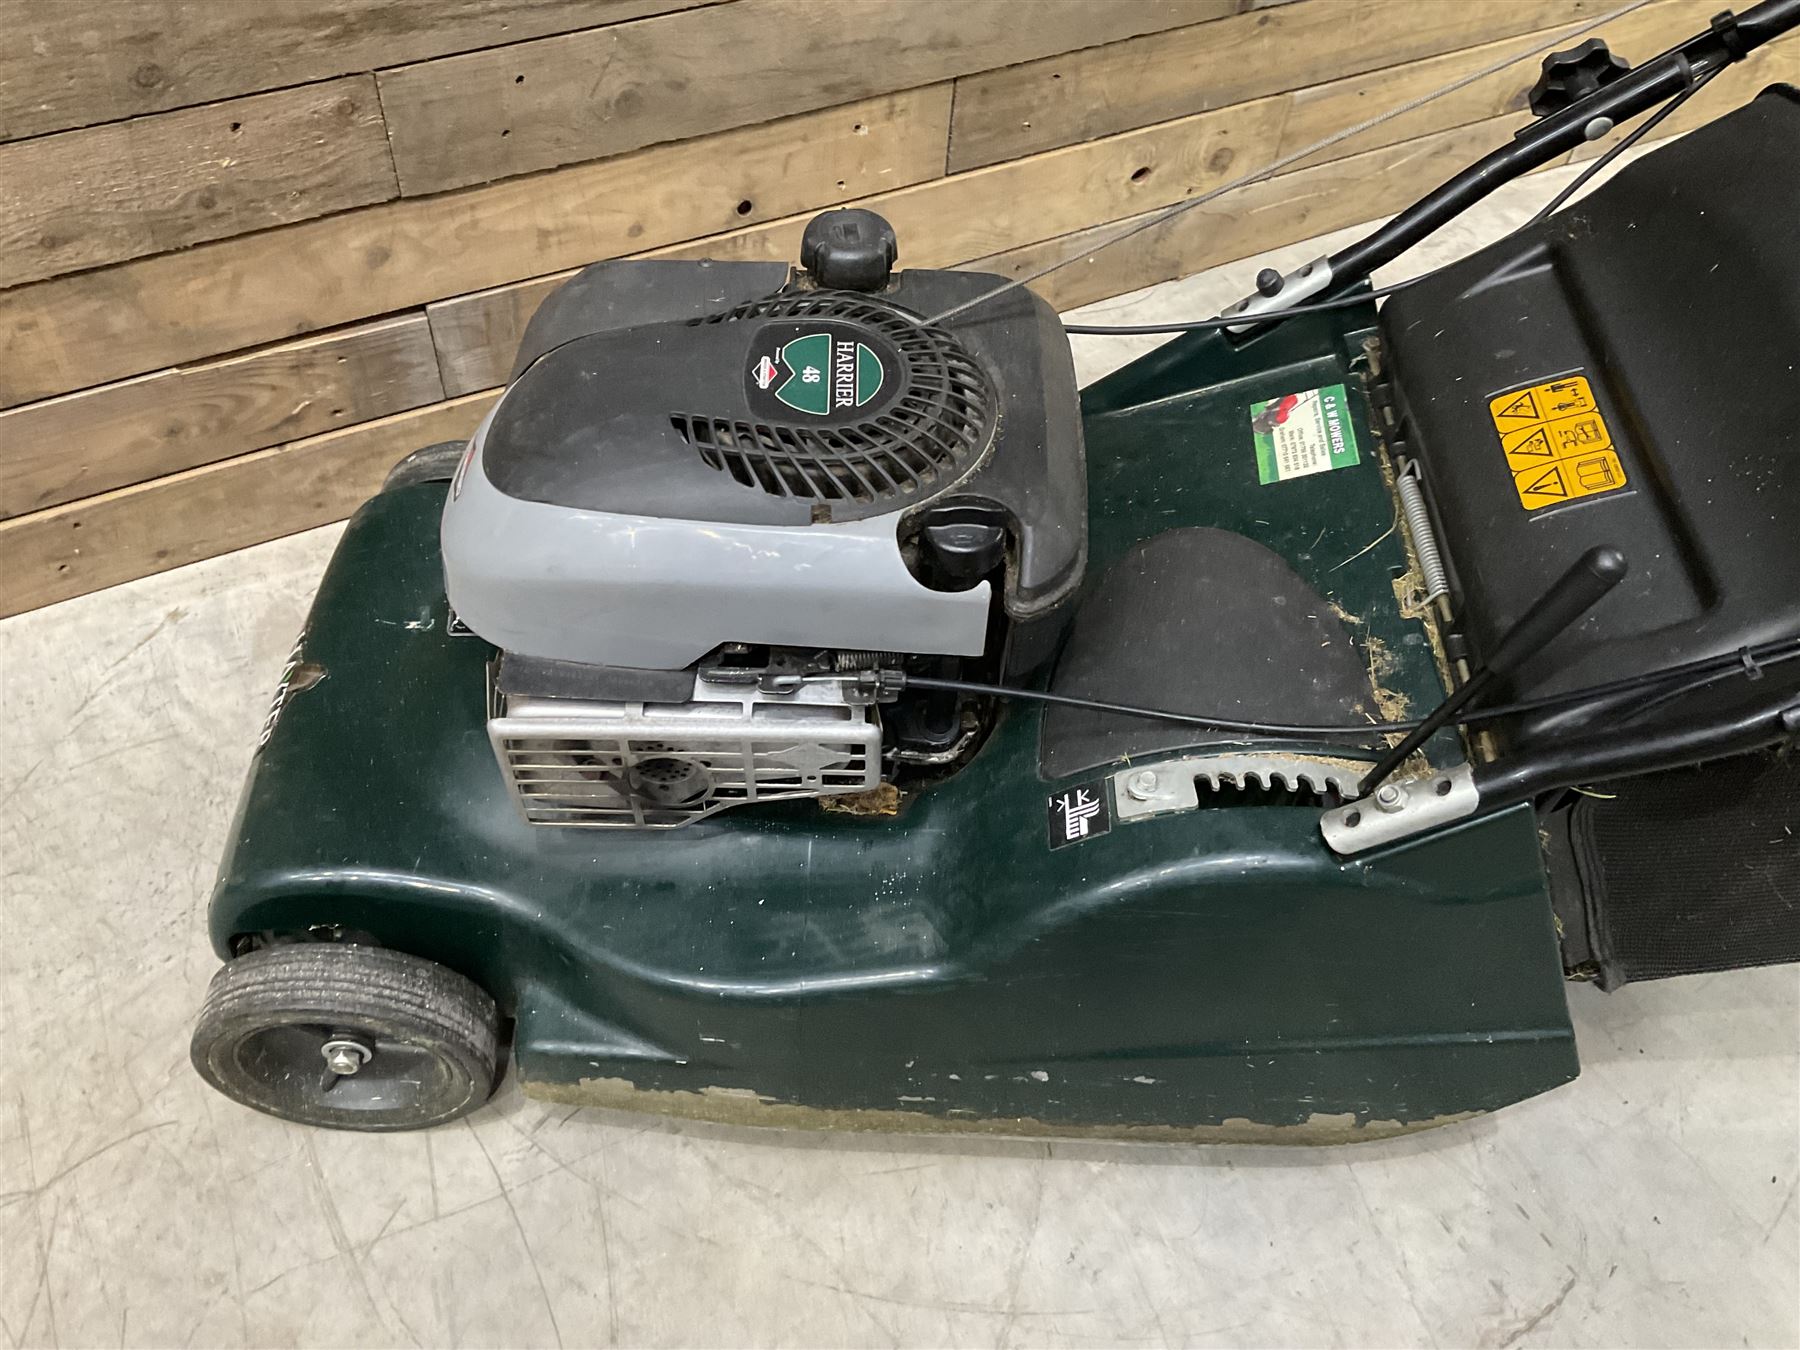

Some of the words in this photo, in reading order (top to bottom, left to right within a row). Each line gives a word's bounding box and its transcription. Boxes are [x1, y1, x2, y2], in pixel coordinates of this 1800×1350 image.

[802, 366, 820, 382] 48
[836, 341, 854, 408] HARRIER
[1326, 410, 1337, 418] W
[1328, 419, 1345, 454] MOWERS
